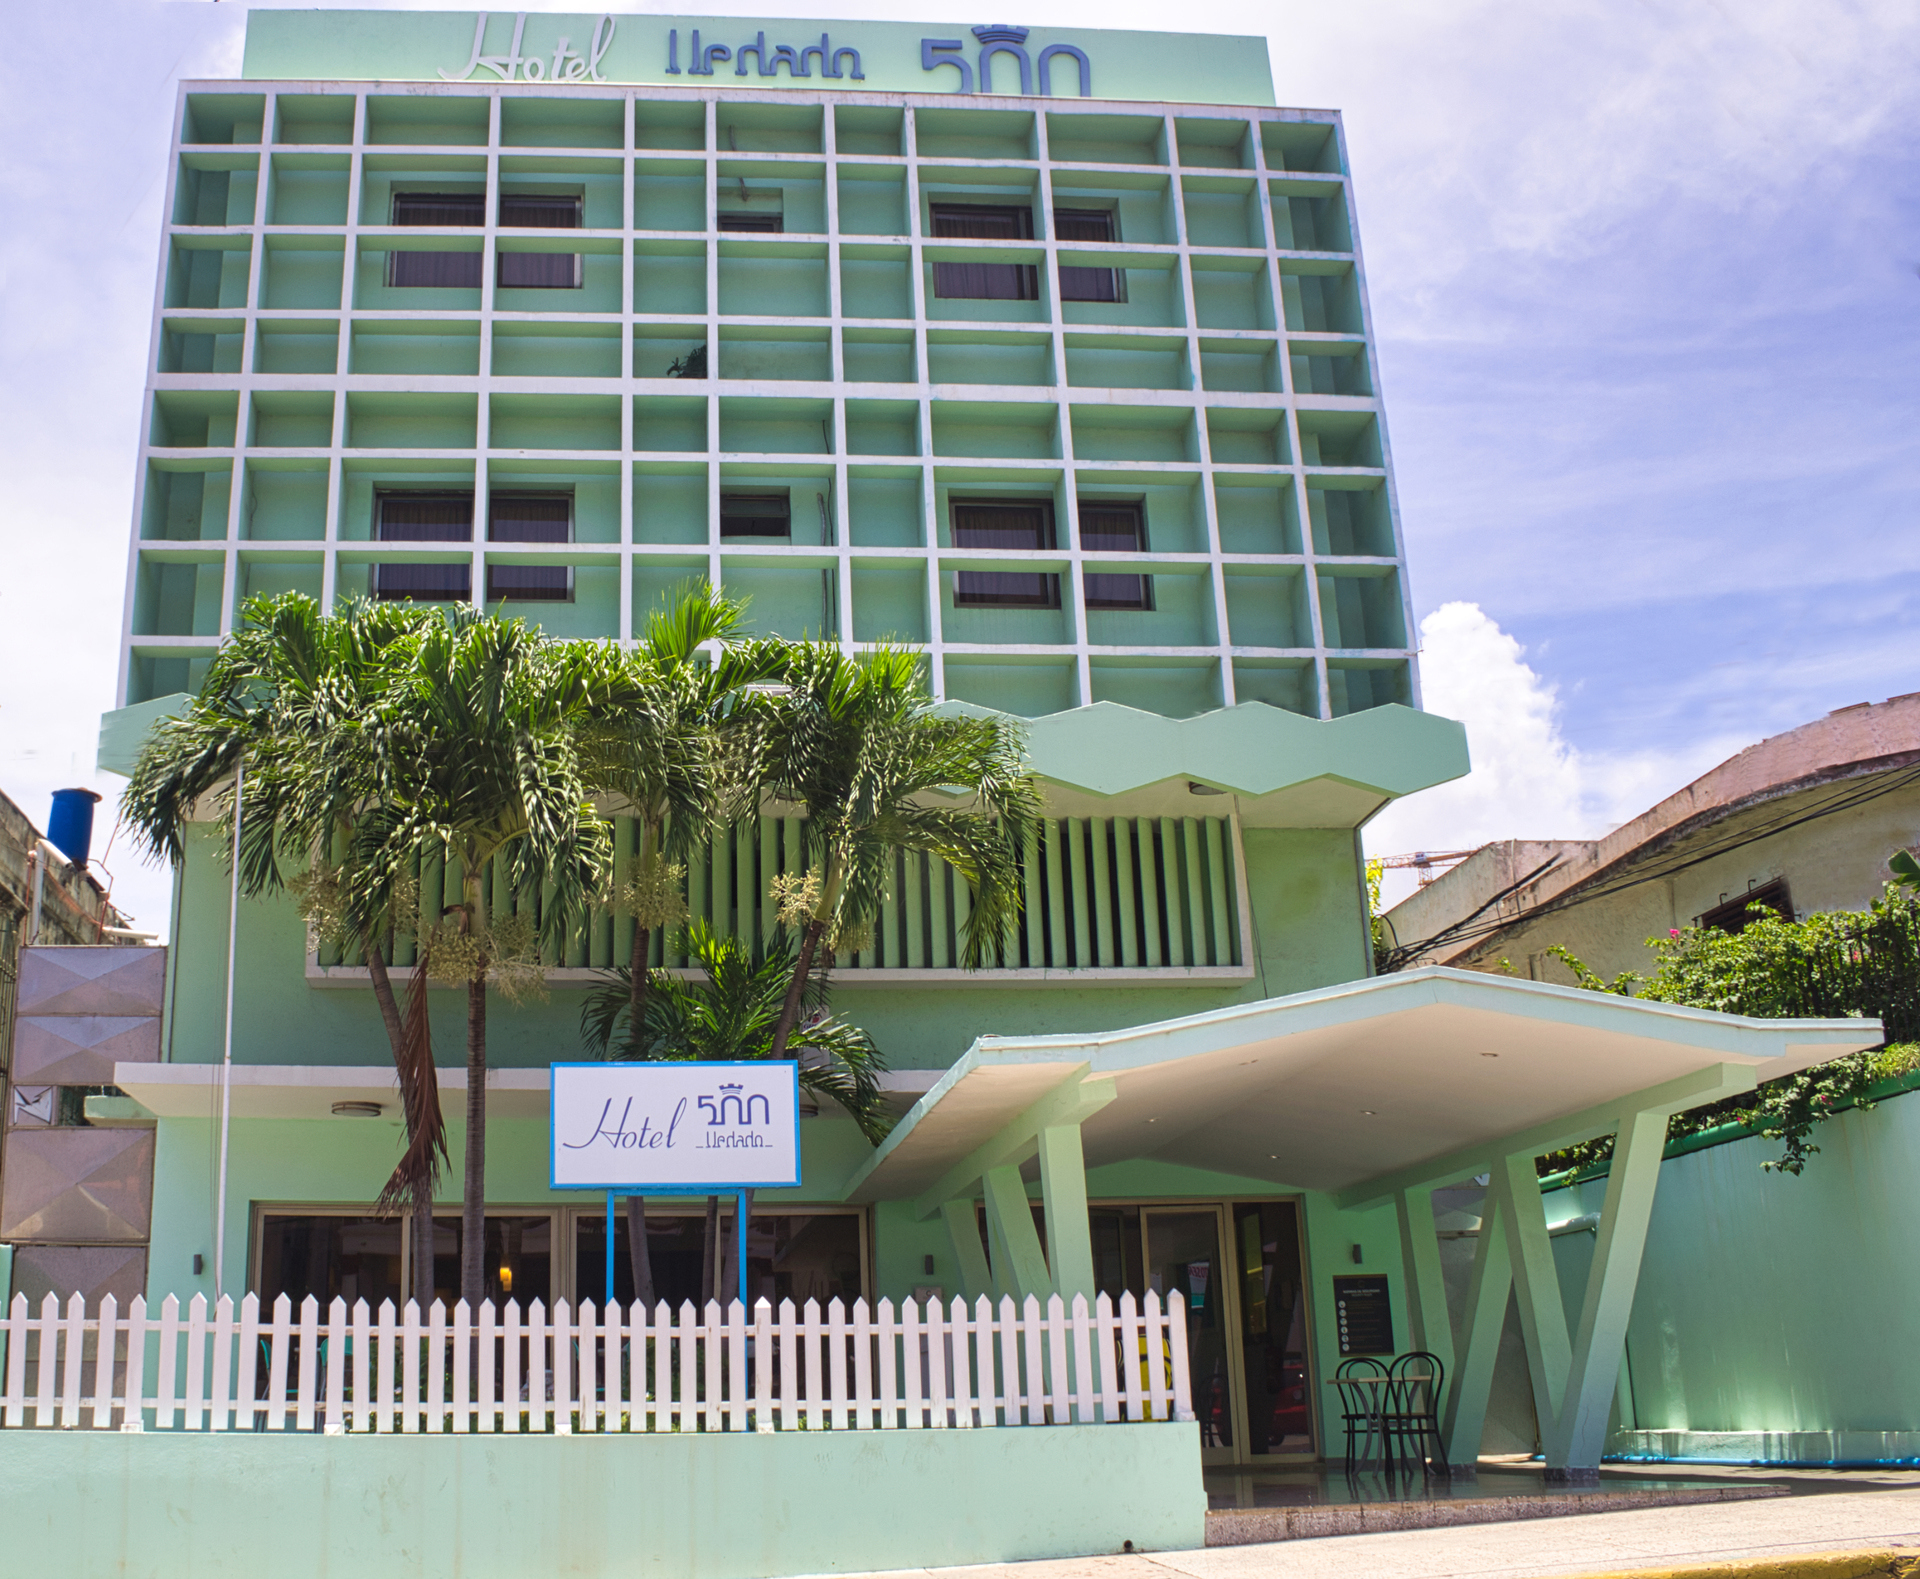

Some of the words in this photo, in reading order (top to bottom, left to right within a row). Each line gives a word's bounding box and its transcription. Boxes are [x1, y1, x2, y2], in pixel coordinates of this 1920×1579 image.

[437, 11, 616, 83] Hotel
[921, 39, 1092, 98] 500
[562, 1095, 688, 1149] Hotel
[697, 1093, 770, 1126] 500
